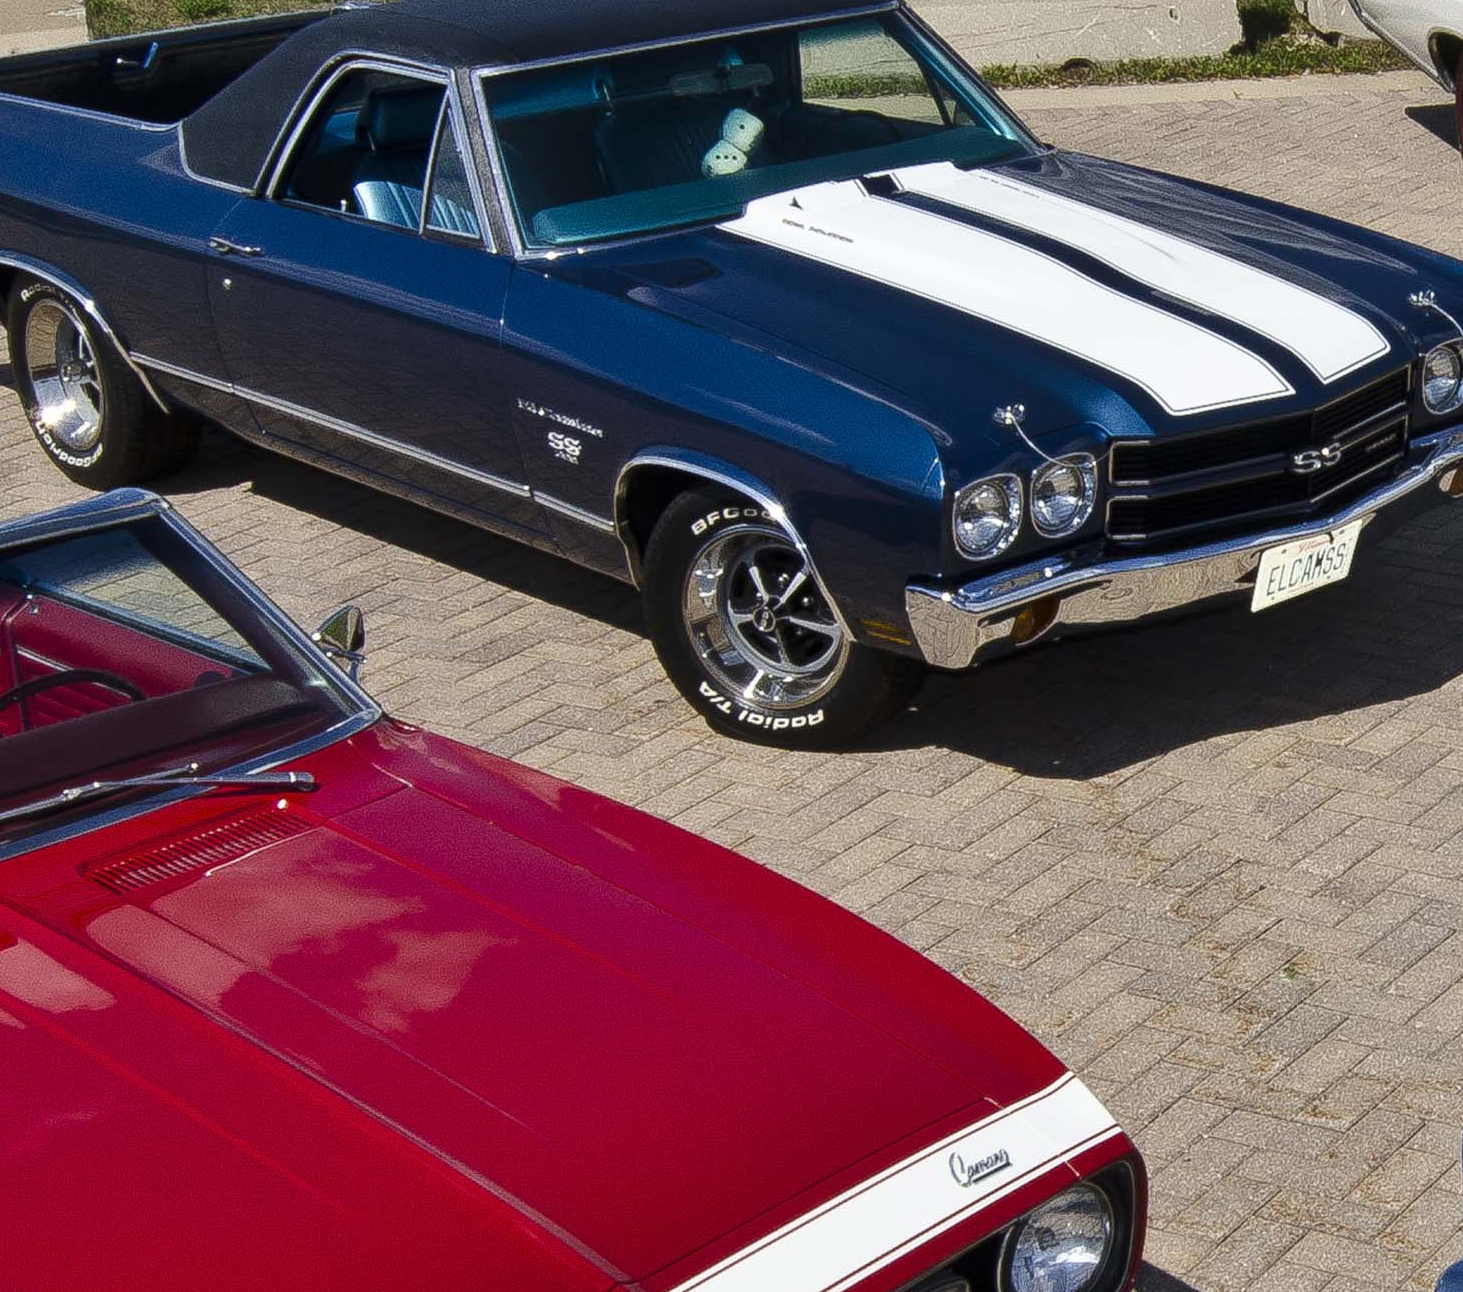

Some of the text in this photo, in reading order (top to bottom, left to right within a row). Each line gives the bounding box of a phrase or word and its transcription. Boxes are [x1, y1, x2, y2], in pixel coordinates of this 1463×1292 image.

[547, 431, 582, 456] SS
[1294, 441, 1341, 473] SS
[699, 681, 825, 730] Radial T/A
